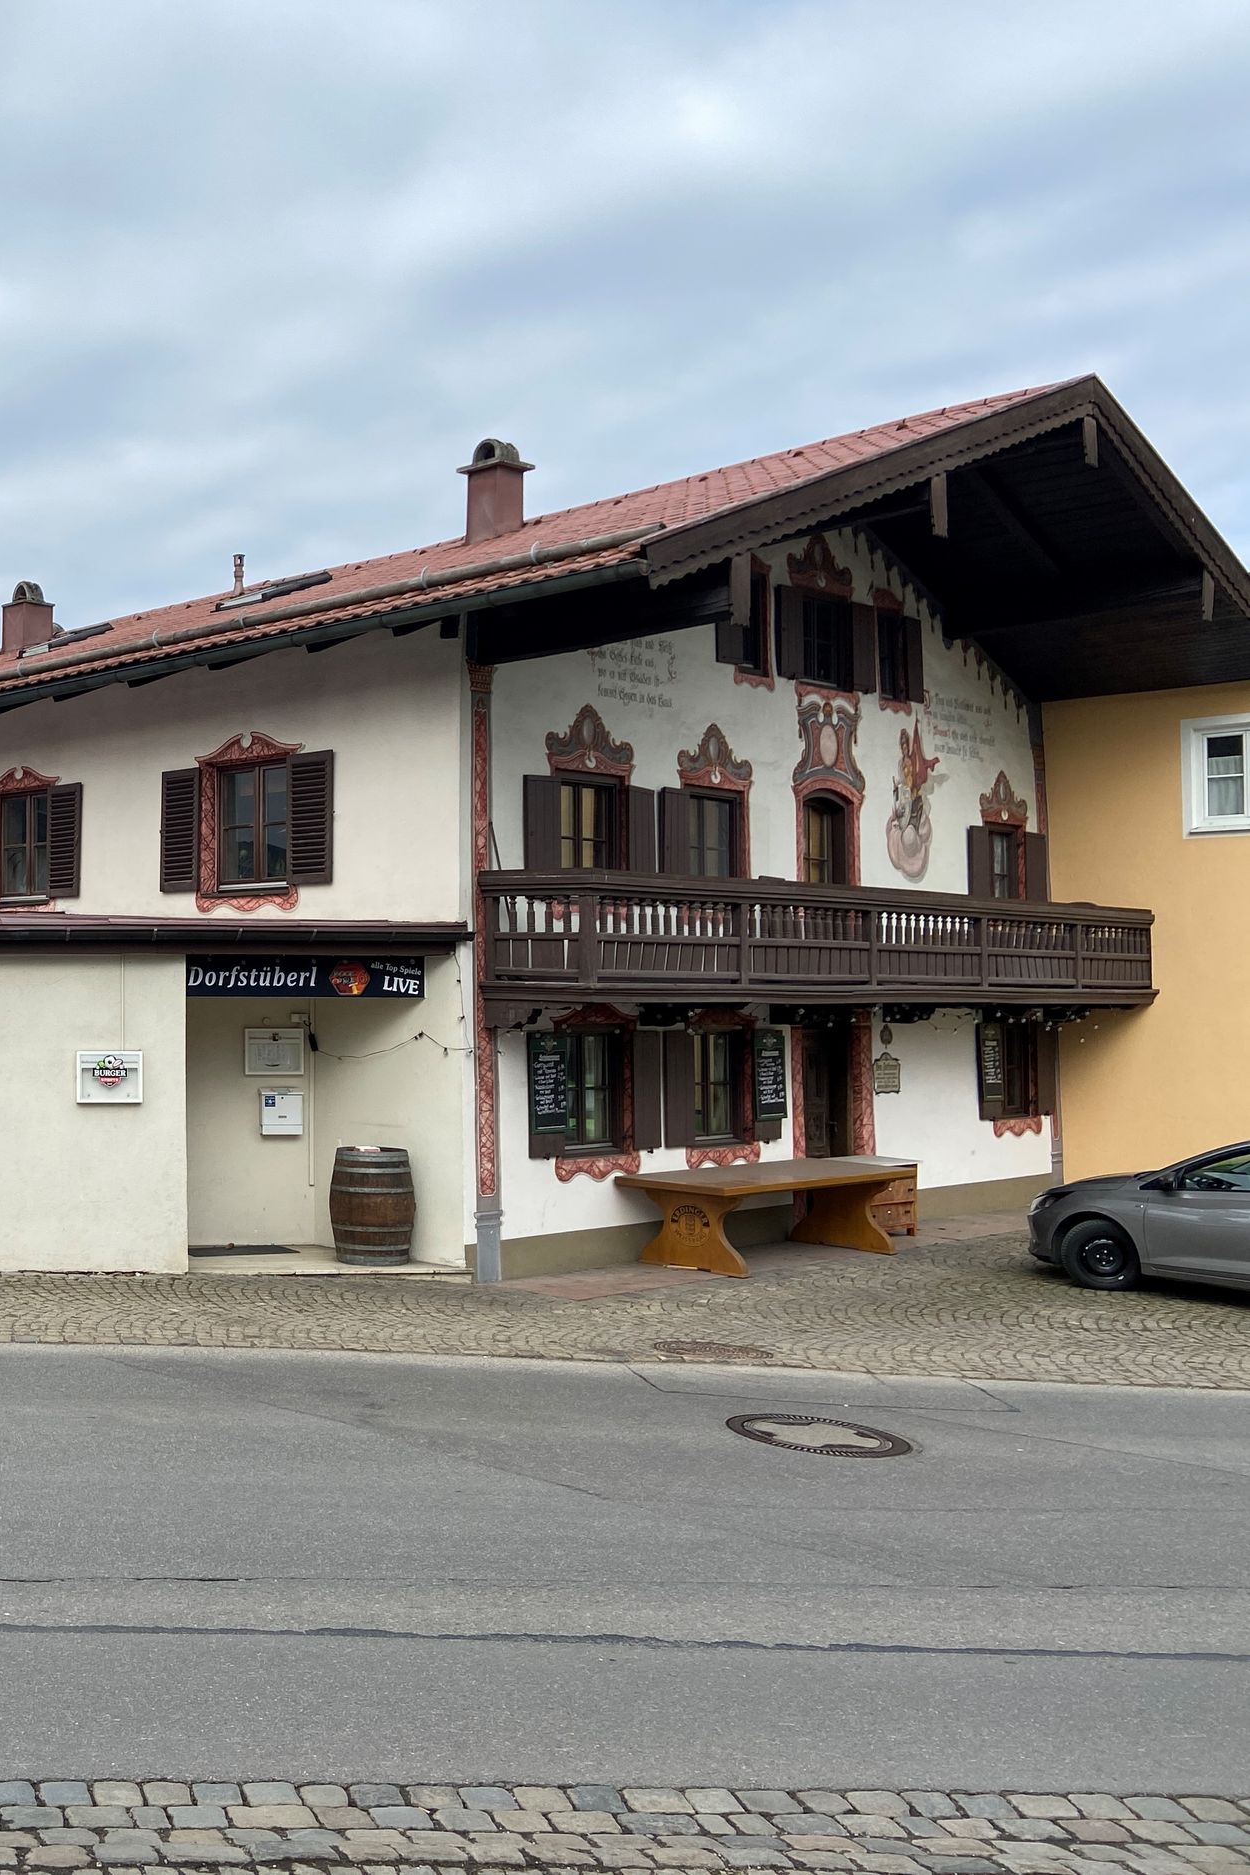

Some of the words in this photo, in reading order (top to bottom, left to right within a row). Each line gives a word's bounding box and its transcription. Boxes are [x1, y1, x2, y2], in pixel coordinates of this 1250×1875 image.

[188, 966, 316, 988] Dorfstüberl
[371, 961, 384, 970] alle
[385, 963, 398, 973] Top
[399, 965, 422, 976] Spiele
[383, 976, 420, 995] LIVE
[672, 1206, 708, 1224] ERDINGER
